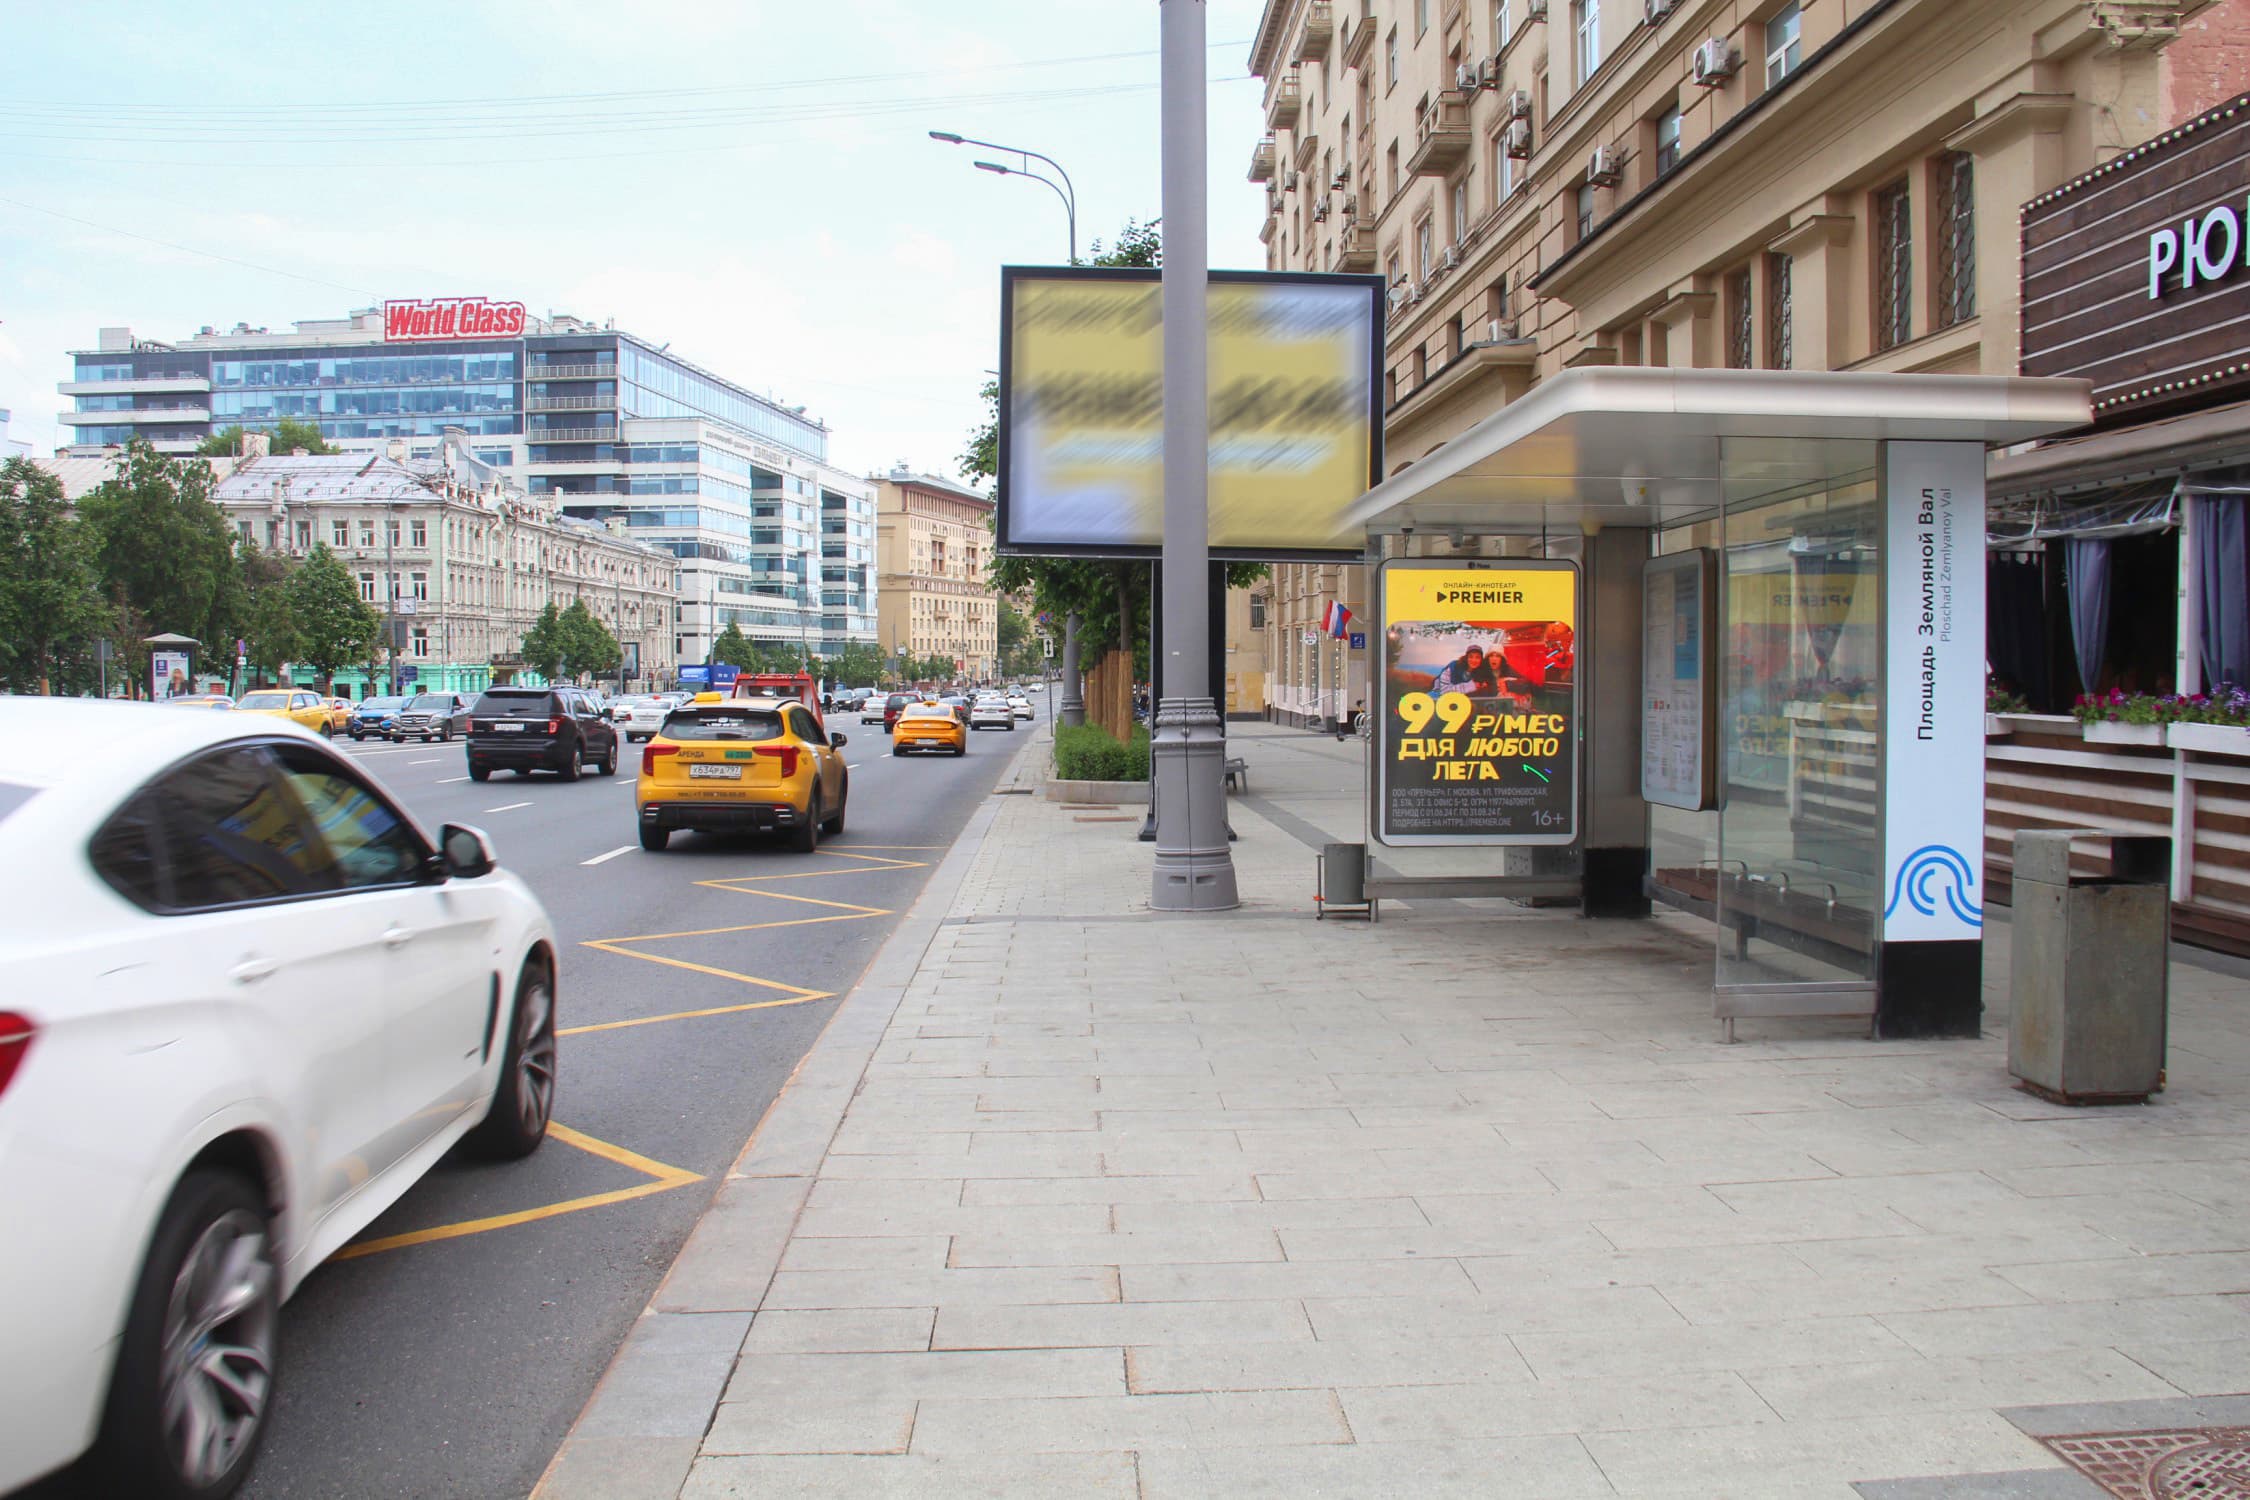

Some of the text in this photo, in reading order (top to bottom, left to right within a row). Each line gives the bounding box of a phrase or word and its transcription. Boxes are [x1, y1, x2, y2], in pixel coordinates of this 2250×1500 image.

[2149, 195, 2250, 300] РЮ
[389, 302, 521, 336] World Class
[1940, 488, 1954, 643] Ploschad Zemlyanoy Val
[1443, 581, 1517, 589] ОНЛАЙН-КИНОТЕАТР
[1450, 591, 1523, 604] PREMIER
[1917, 488, 1936, 741] Площадь Земляной Вал
[1398, 691, 1472, 734] 99
[1398, 737, 1559, 761] ДЛЯ ЛЮБОГО
[1432, 761, 1500, 780] ЛЕТА
[1531, 810, 1565, 826] 16+
